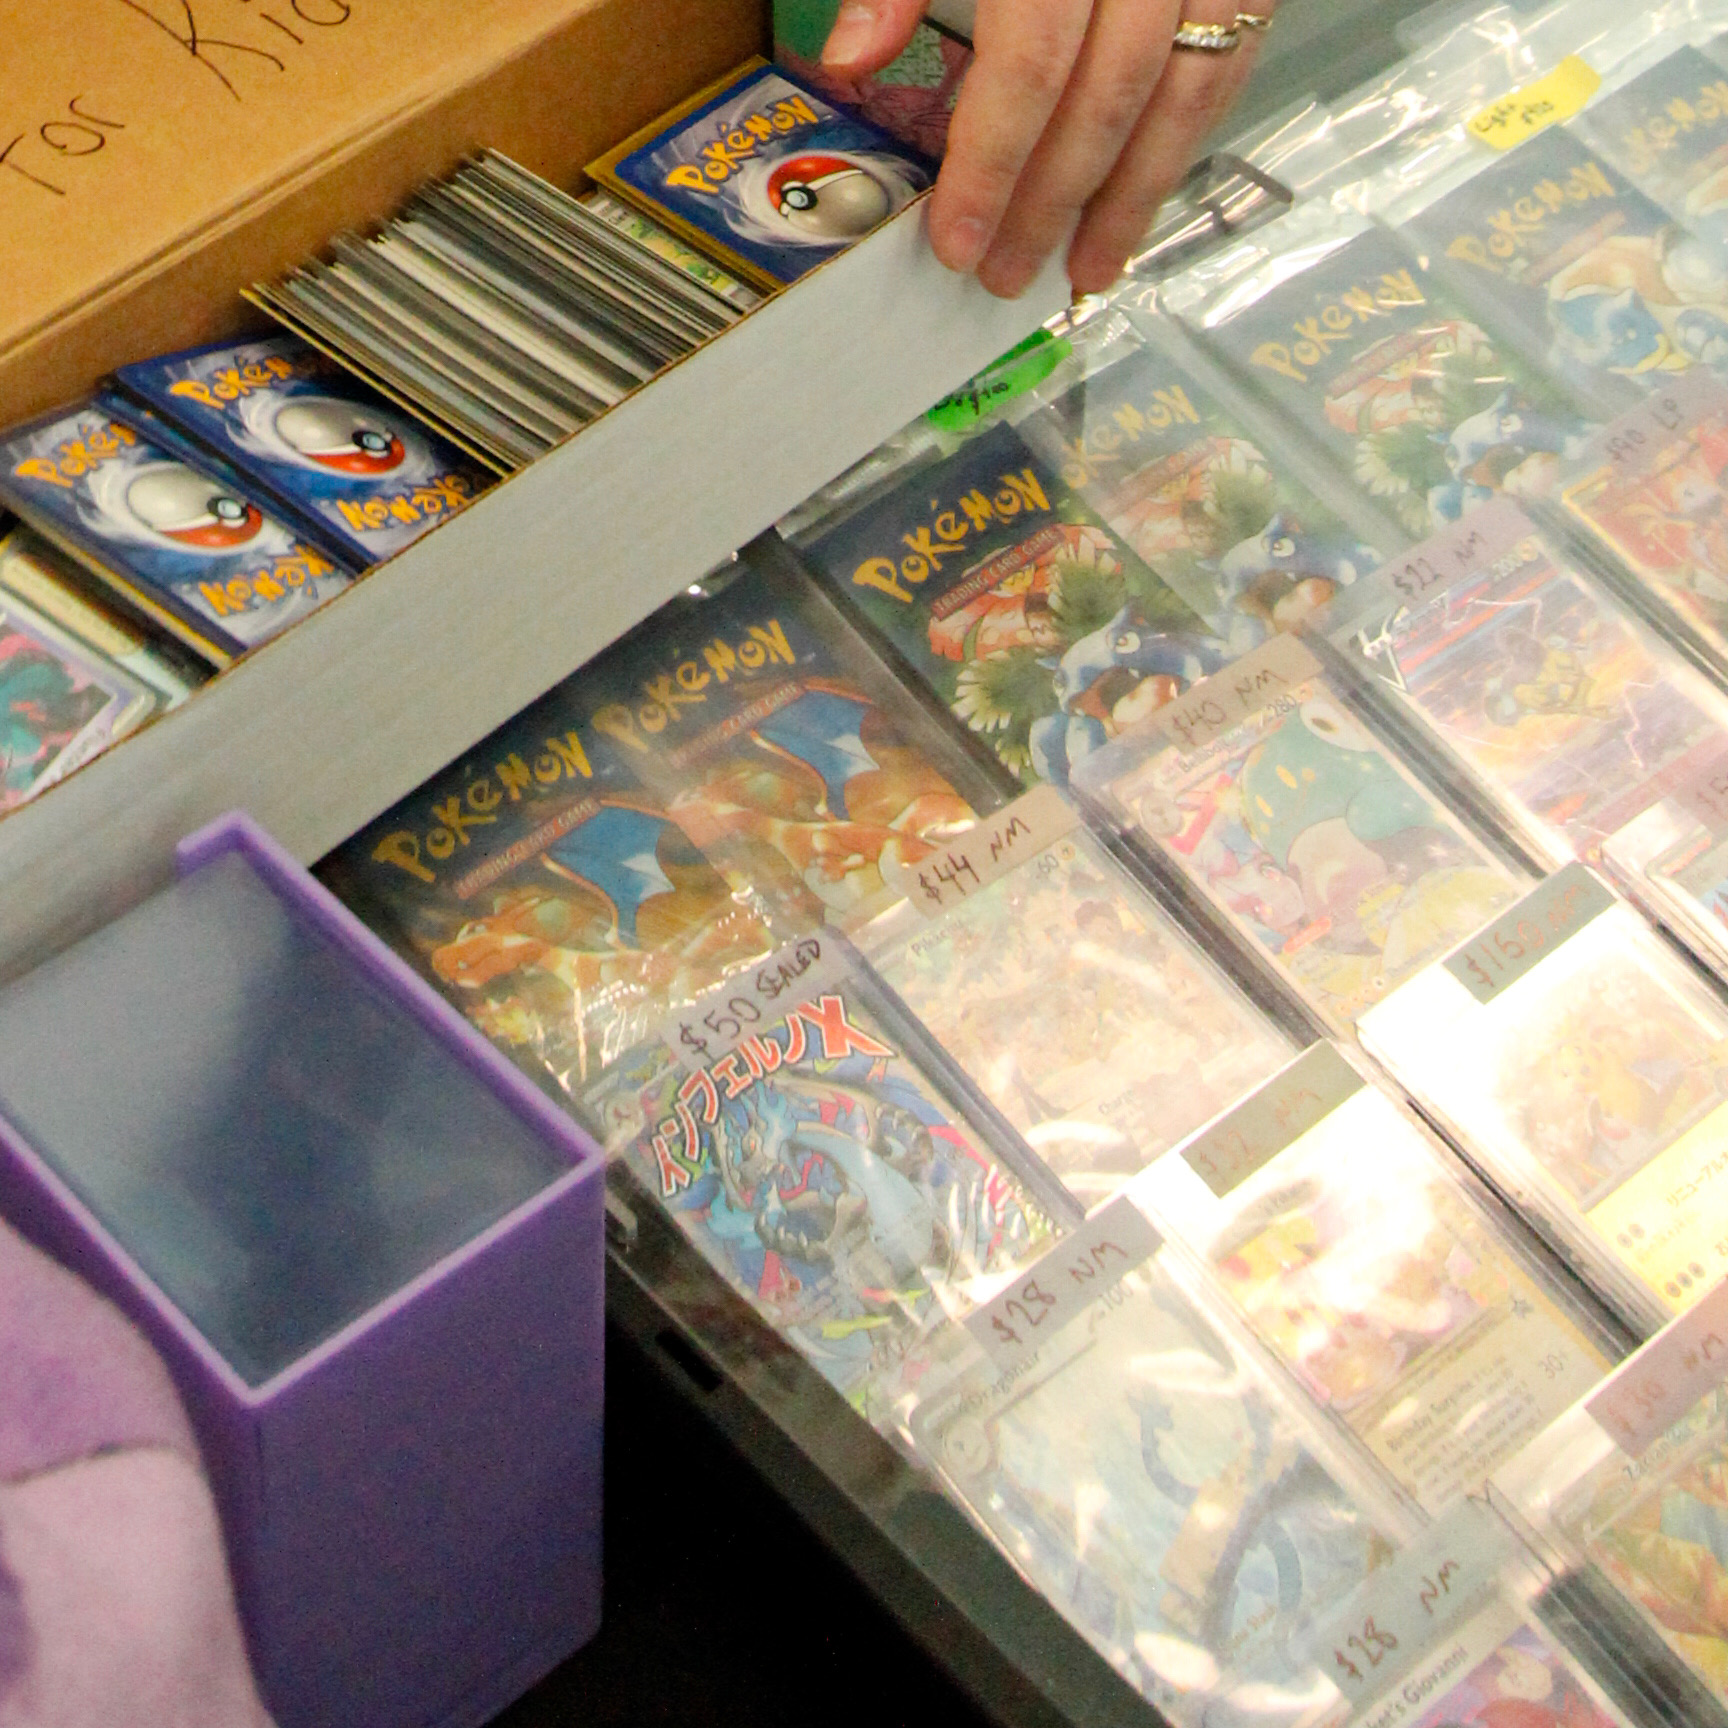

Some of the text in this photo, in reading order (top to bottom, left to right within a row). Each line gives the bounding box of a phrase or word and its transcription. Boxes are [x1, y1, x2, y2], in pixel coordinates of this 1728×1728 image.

[933, 527, 1057, 609] TRADING CARD GAME
[1234, 669, 1290, 708] NM
[918, 816, 1031, 905] $44 NM
[680, 939, 821, 1061] $50 SEALED
[991, 1240, 1129, 1345] $28 NM
[1334, 1615, 1399, 1682] $28
[1419, 1559, 1460, 1614] NM
